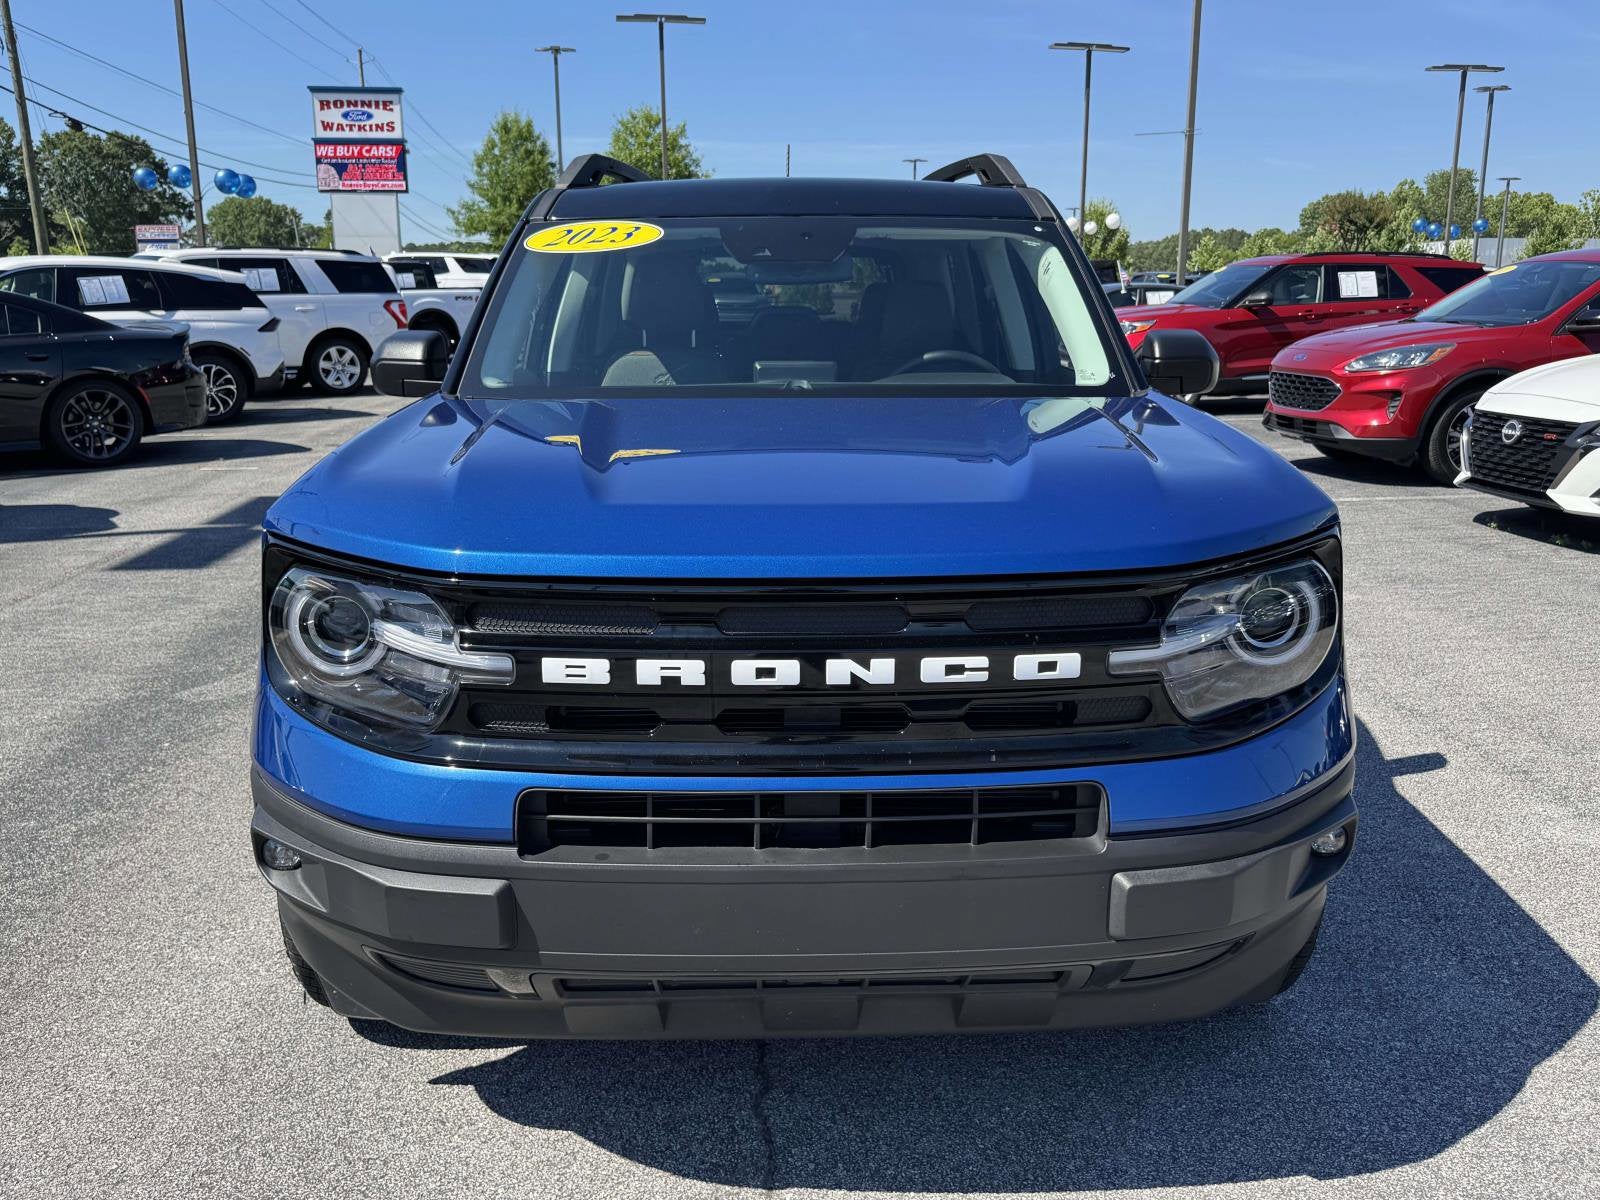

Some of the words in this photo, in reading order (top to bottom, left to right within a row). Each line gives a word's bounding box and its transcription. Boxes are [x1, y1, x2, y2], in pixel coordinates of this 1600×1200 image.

[319, 100, 394, 112] RONNIE
[347, 111, 368, 121] Ford
[320, 120, 396, 133] WATKINS
[316, 145, 335, 157] WE
[336, 145, 361, 157] BUY
[362, 145, 396, 157] CARS!
[541, 226, 641, 248] 2023
[541, 652, 1081, 686] BRONCO
